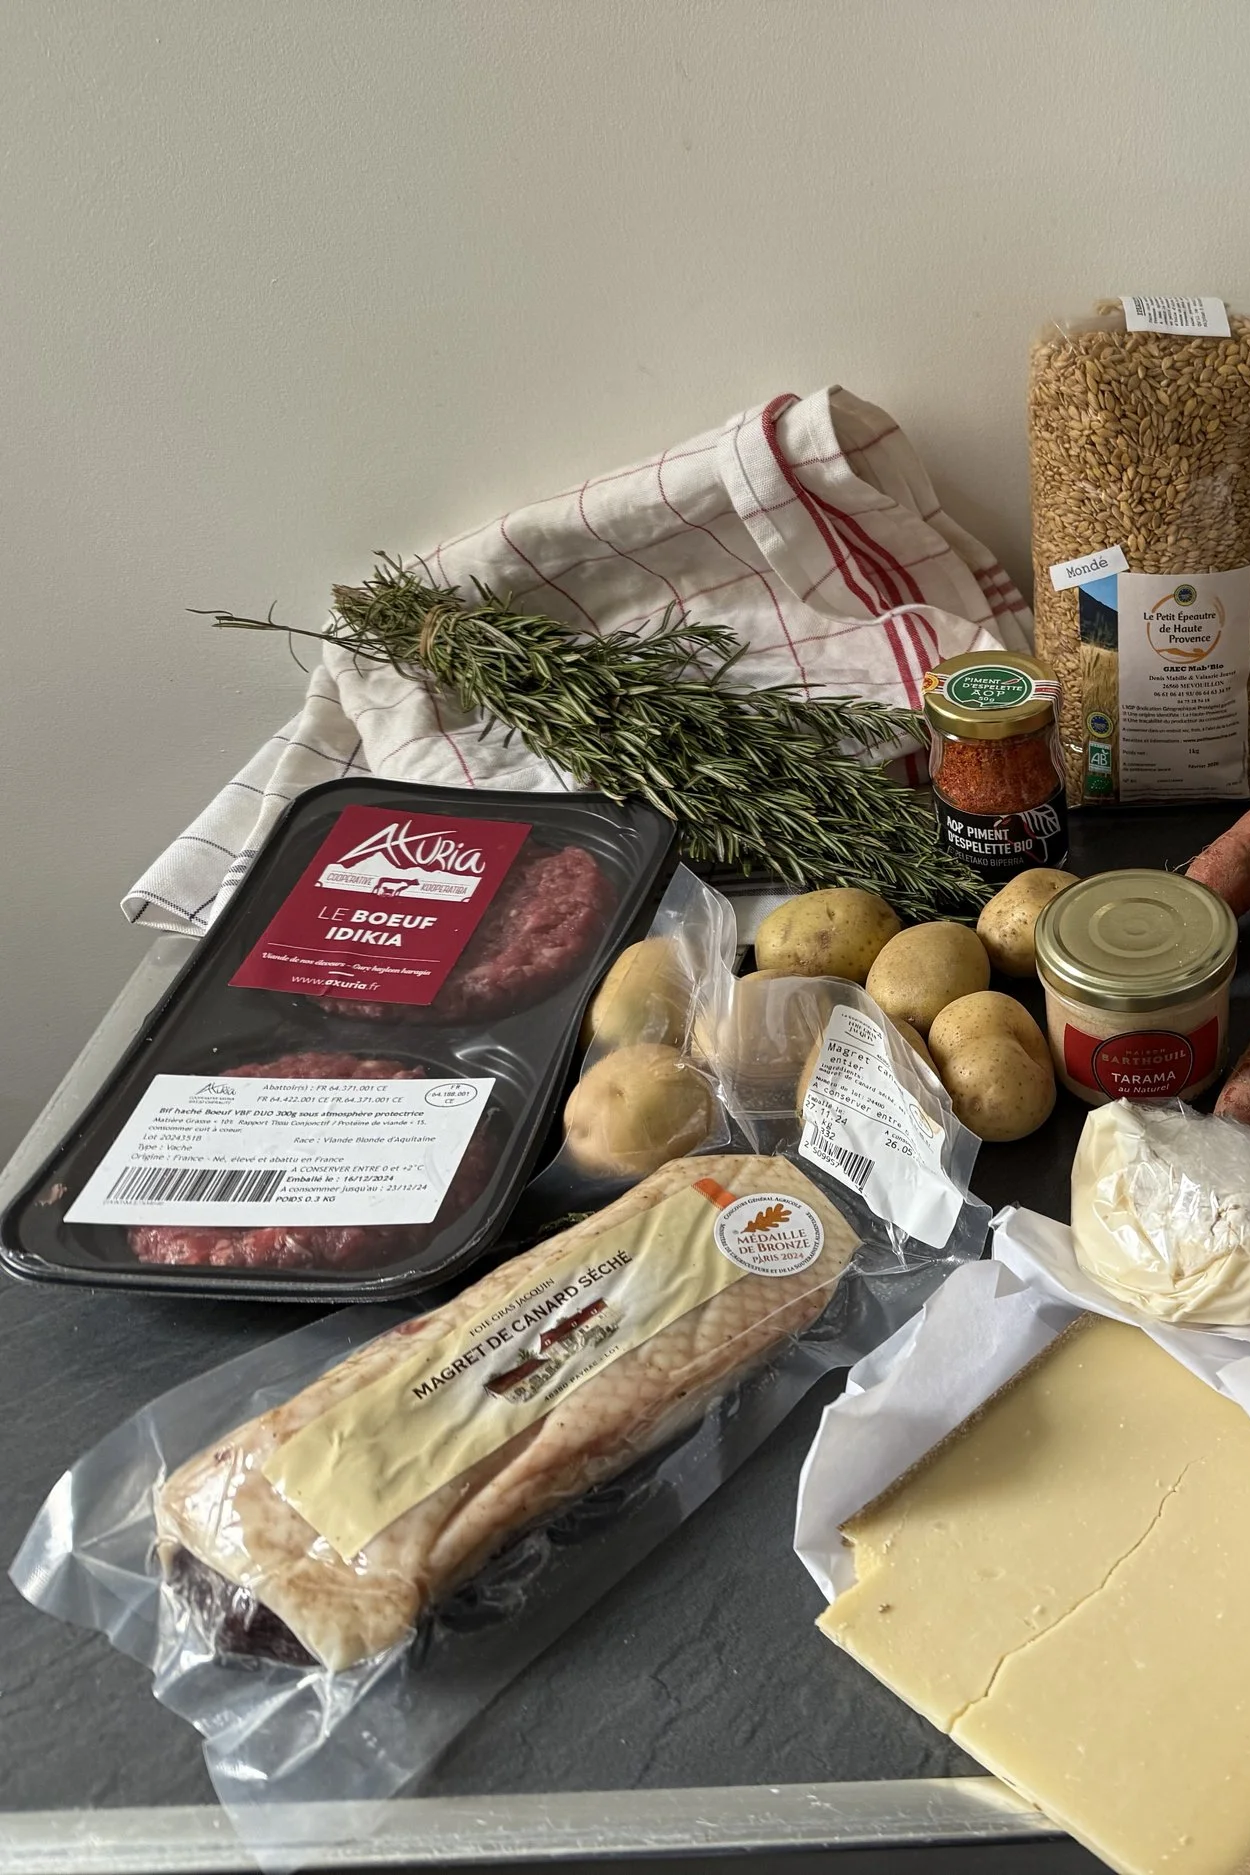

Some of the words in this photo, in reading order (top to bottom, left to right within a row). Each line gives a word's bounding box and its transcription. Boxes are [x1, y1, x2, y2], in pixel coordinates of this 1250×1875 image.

[1065, 555, 1109, 578] Mondé
[1143, 612, 1154, 621] Le
[1156, 612, 1175, 621] Petit
[1177, 610, 1217, 623] Épeautre
[1159, 625, 1171, 633] de
[1173, 624, 1203, 633] Haute
[1169, 635, 1211, 644] Provence
[962, 683, 1023, 691] D'ESPELETTE
[970, 689, 1006, 697] AOP
[1091, 752, 1108, 765] AB
[946, 816, 964, 834] AOP
[967, 826, 1009, 841] PIMENT
[947, 830, 1012, 855] D'ESPELETTE
[1014, 838, 1033, 853] BIO
[317, 905, 350, 922] LE
[350, 909, 438, 930] BOEUF
[324, 926, 402, 947] IDIKIA
[291, 974, 381, 991] www.axuria.fr
[827, 1042, 871, 1065] Magret
[1101, 1050, 1186, 1066] BARTHOUIL
[830, 1056, 865, 1071] entier
[1111, 1070, 1176, 1084] TARAMA
[263, 1084, 308, 1092] Abattoir(s)
[1133, 1084, 1169, 1093] Naturel
[204, 1108, 232, 1116] Boeuf
[276, 1110, 297, 1118] 300g
[320, 1110, 373, 1118] atmosphère
[805, 1101, 848, 1125] 27.11.24
[824, 1087, 872, 1112] conserver
[876, 1111, 902, 1128] entre
[821, 1118, 833, 1130] kg
[130, 1154, 165, 1162] Origine
[737, 1228, 807, 1245] MÉDAILLE
[738, 1247, 756, 1255] DE
[757, 1238, 811, 1252] BRONZE
[752, 1253, 779, 1264] PARIS
[781, 1252, 804, 1261] 2024
[491, 1303, 516, 1321] GRAS
[515, 1277, 555, 1307] JACQUIN
[412, 1344, 488, 1400] MAGRET
[486, 1328, 514, 1351] DE
[511, 1285, 579, 1333] CANARD
[578, 1249, 633, 1289] SÉCHÉ
